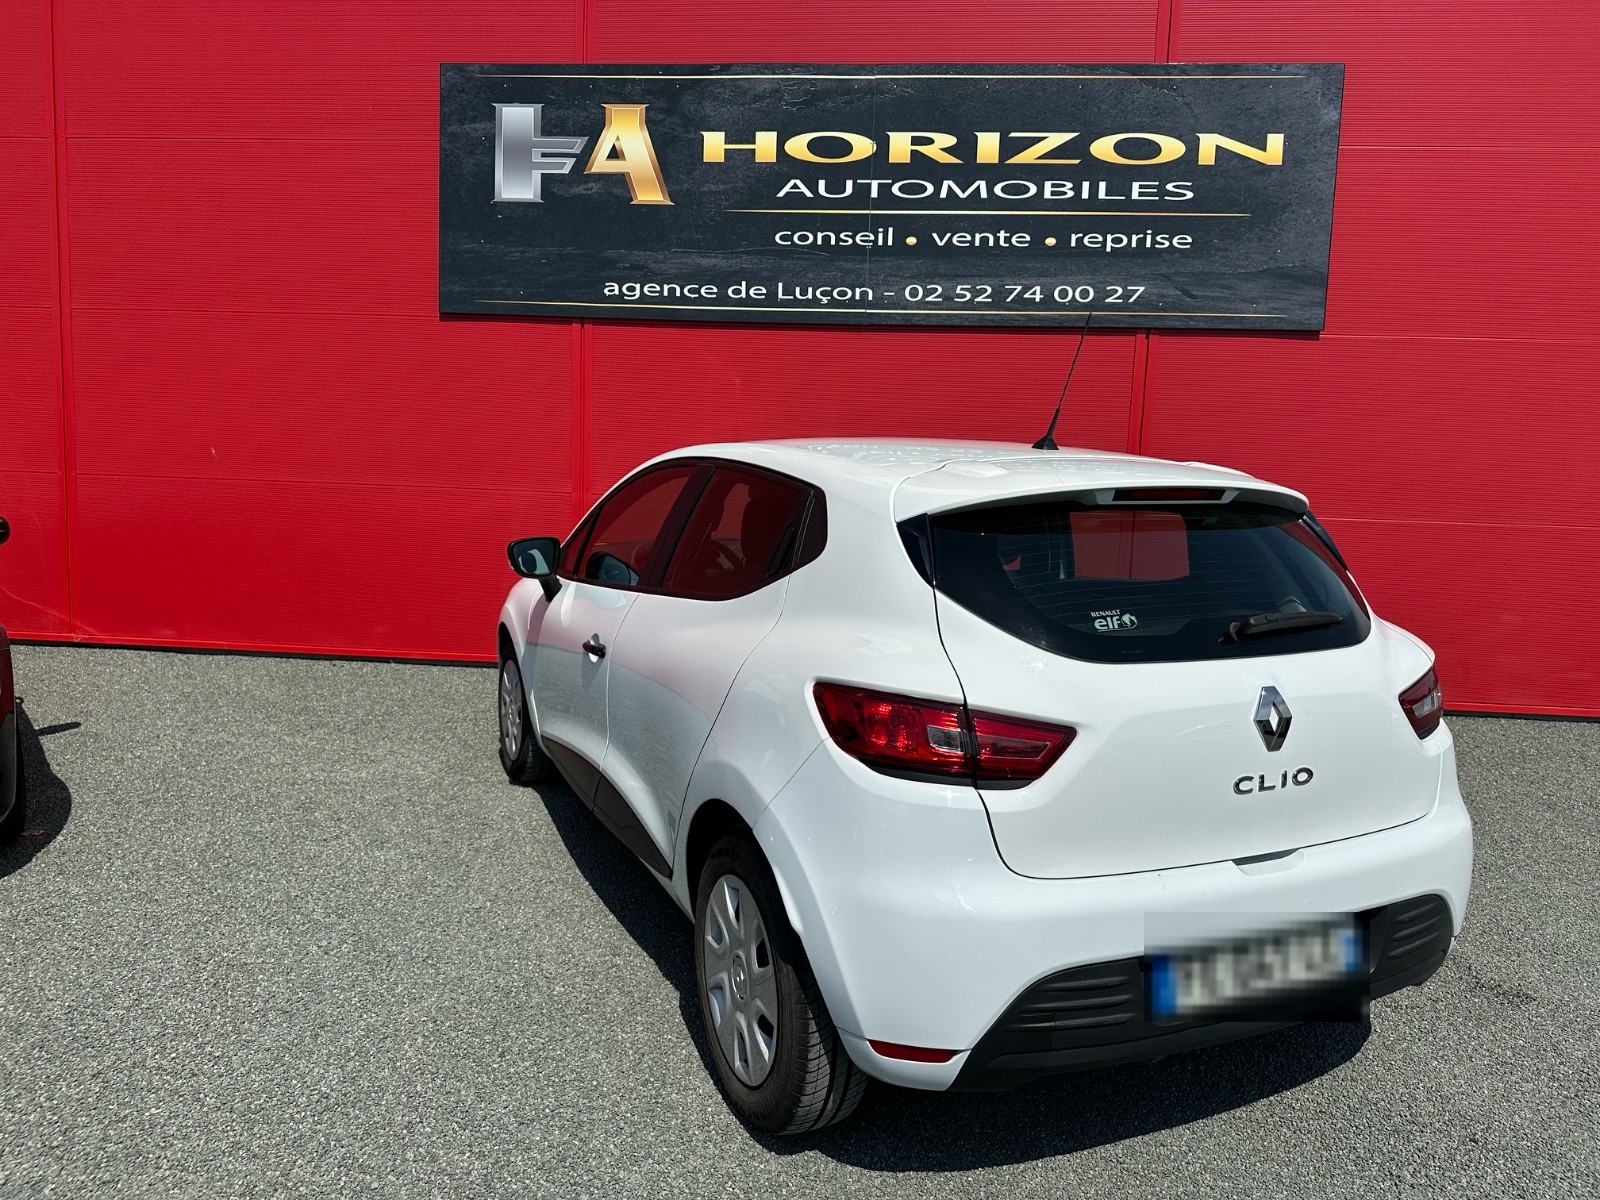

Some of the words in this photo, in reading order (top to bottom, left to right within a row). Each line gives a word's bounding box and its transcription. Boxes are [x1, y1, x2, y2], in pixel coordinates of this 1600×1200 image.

[699, 130, 1286, 166] HORIZON
[775, 178, 1196, 201] AUTOMOBILES
[774, 226, 895, 246] conseil
[931, 229, 1032, 247] vente
[1069, 229, 1194, 252] reprise
[602, 281, 719, 300] agence
[727, 280, 767, 299] de
[776, 282, 874, 304] Luçon
[904, 284, 944, 302] 02
[953, 284, 993, 302] 52
[1004, 285, 1044, 303] 74
[1053, 285, 1095, 303] 00
[1104, 285, 1146, 303] 27
[1091, 609, 1121, 618] RENAULT
[1094, 616, 1121, 630] elf
[1232, 766, 1314, 796] CLIO
